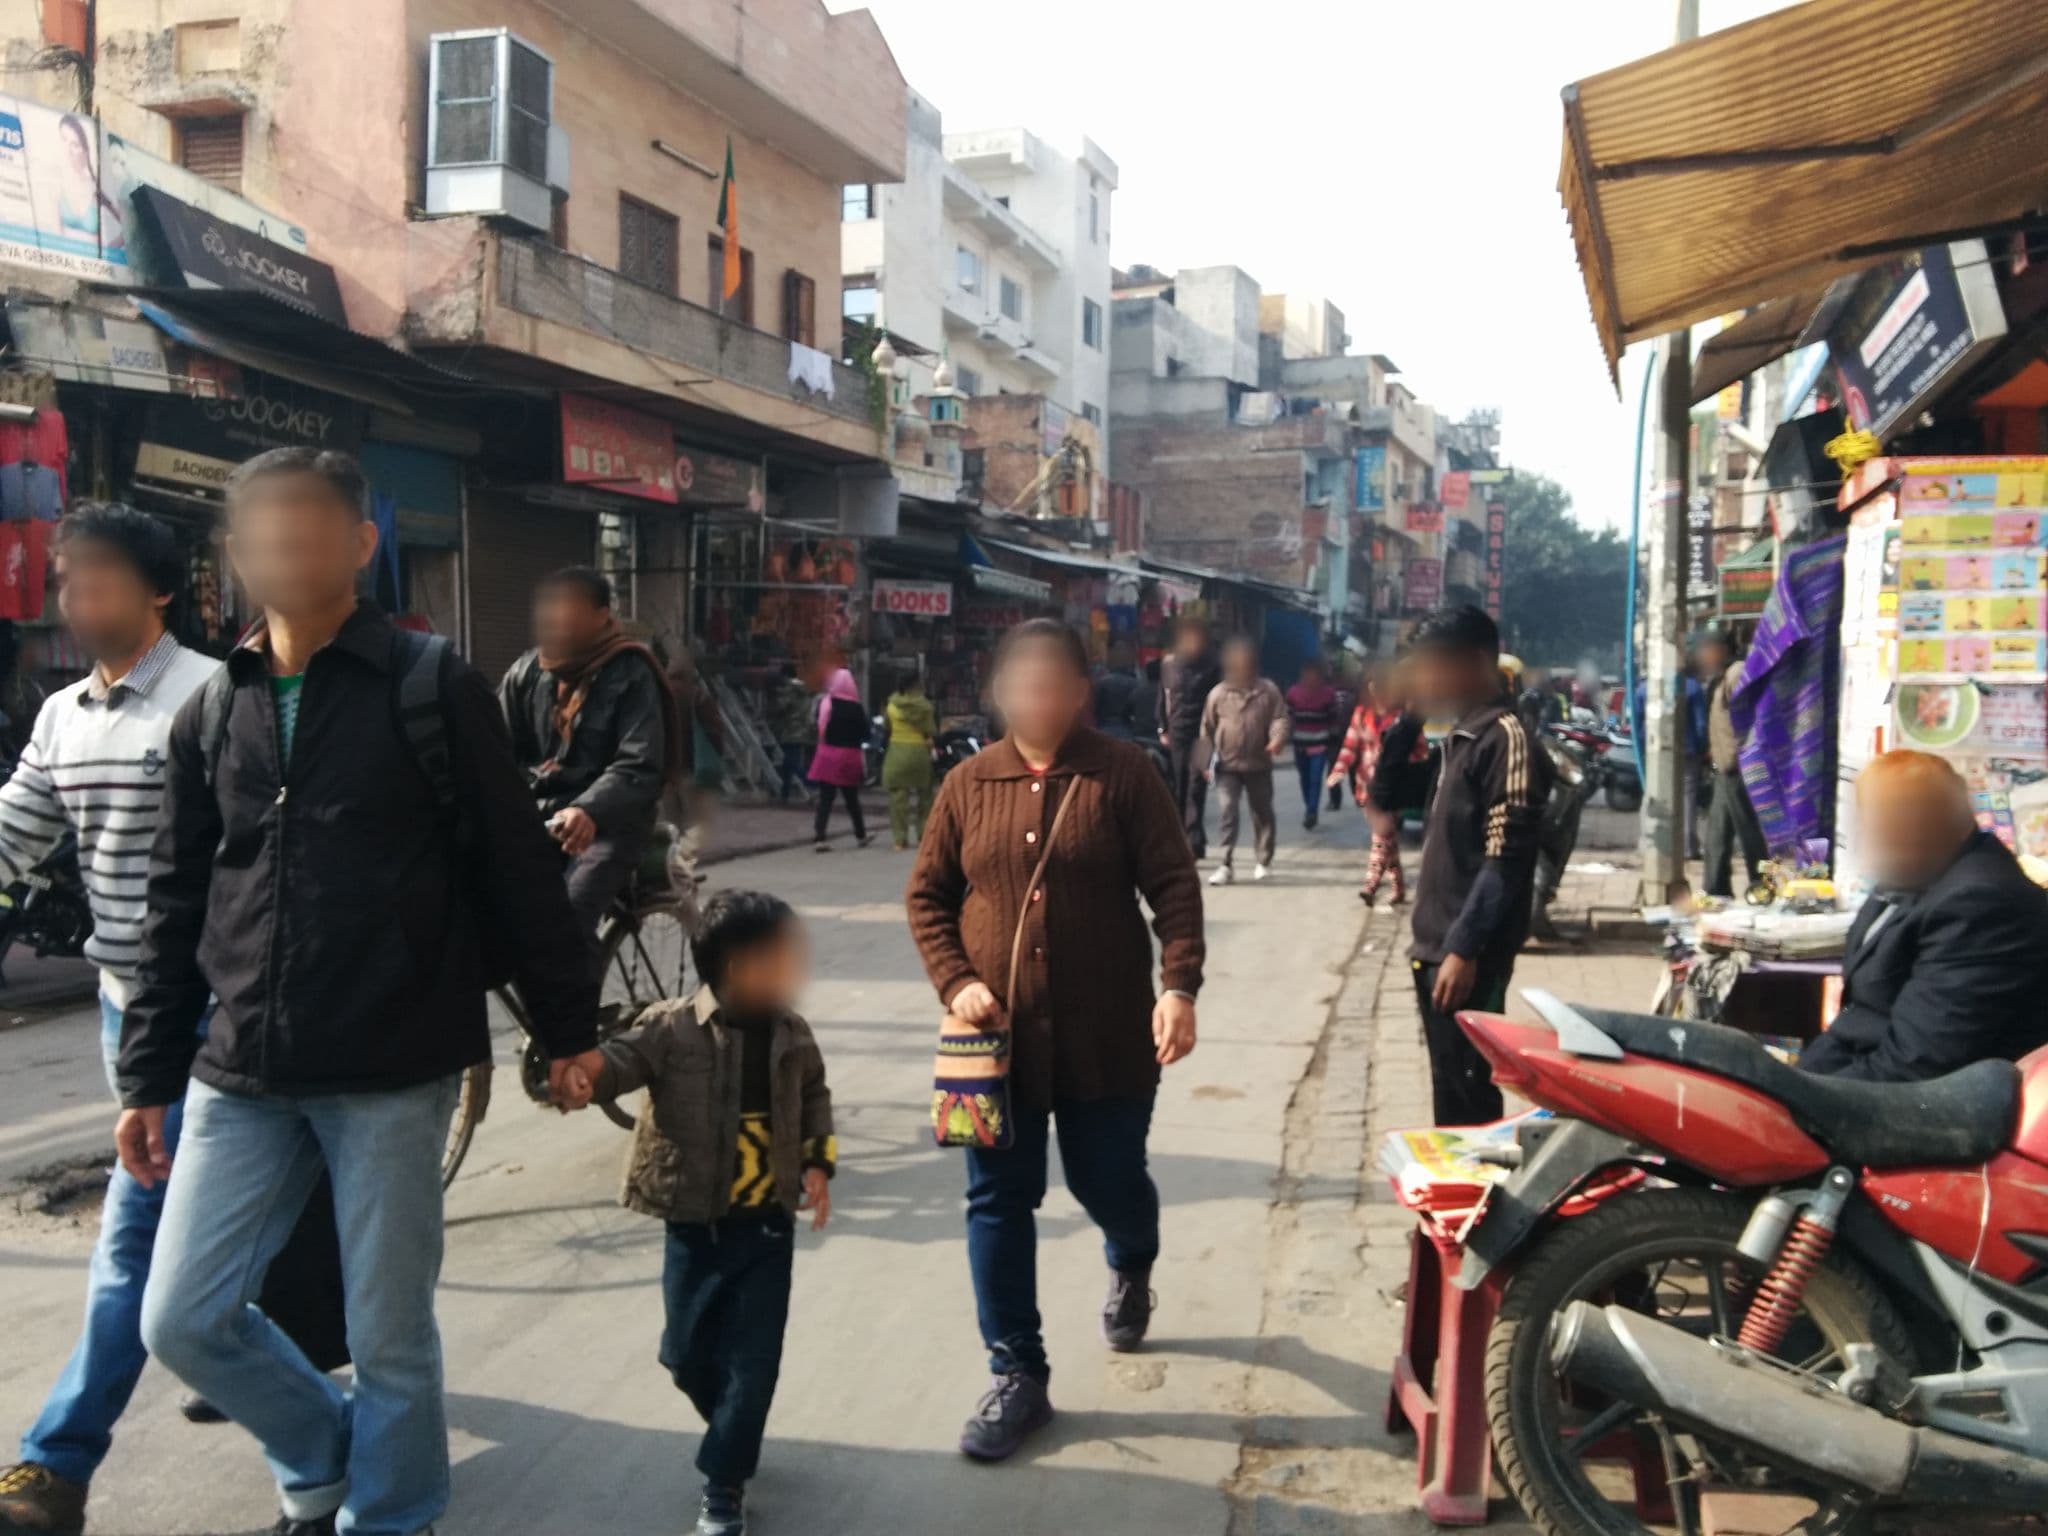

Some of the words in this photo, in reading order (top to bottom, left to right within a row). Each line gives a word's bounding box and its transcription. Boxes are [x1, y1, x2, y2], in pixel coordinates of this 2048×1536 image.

[24, 247, 76, 272] GENERAL
[234, 248, 308, 294] JOCKEY
[230, 391, 332, 440] JOCKEY
[1881, 1193, 1912, 1211] TVS
